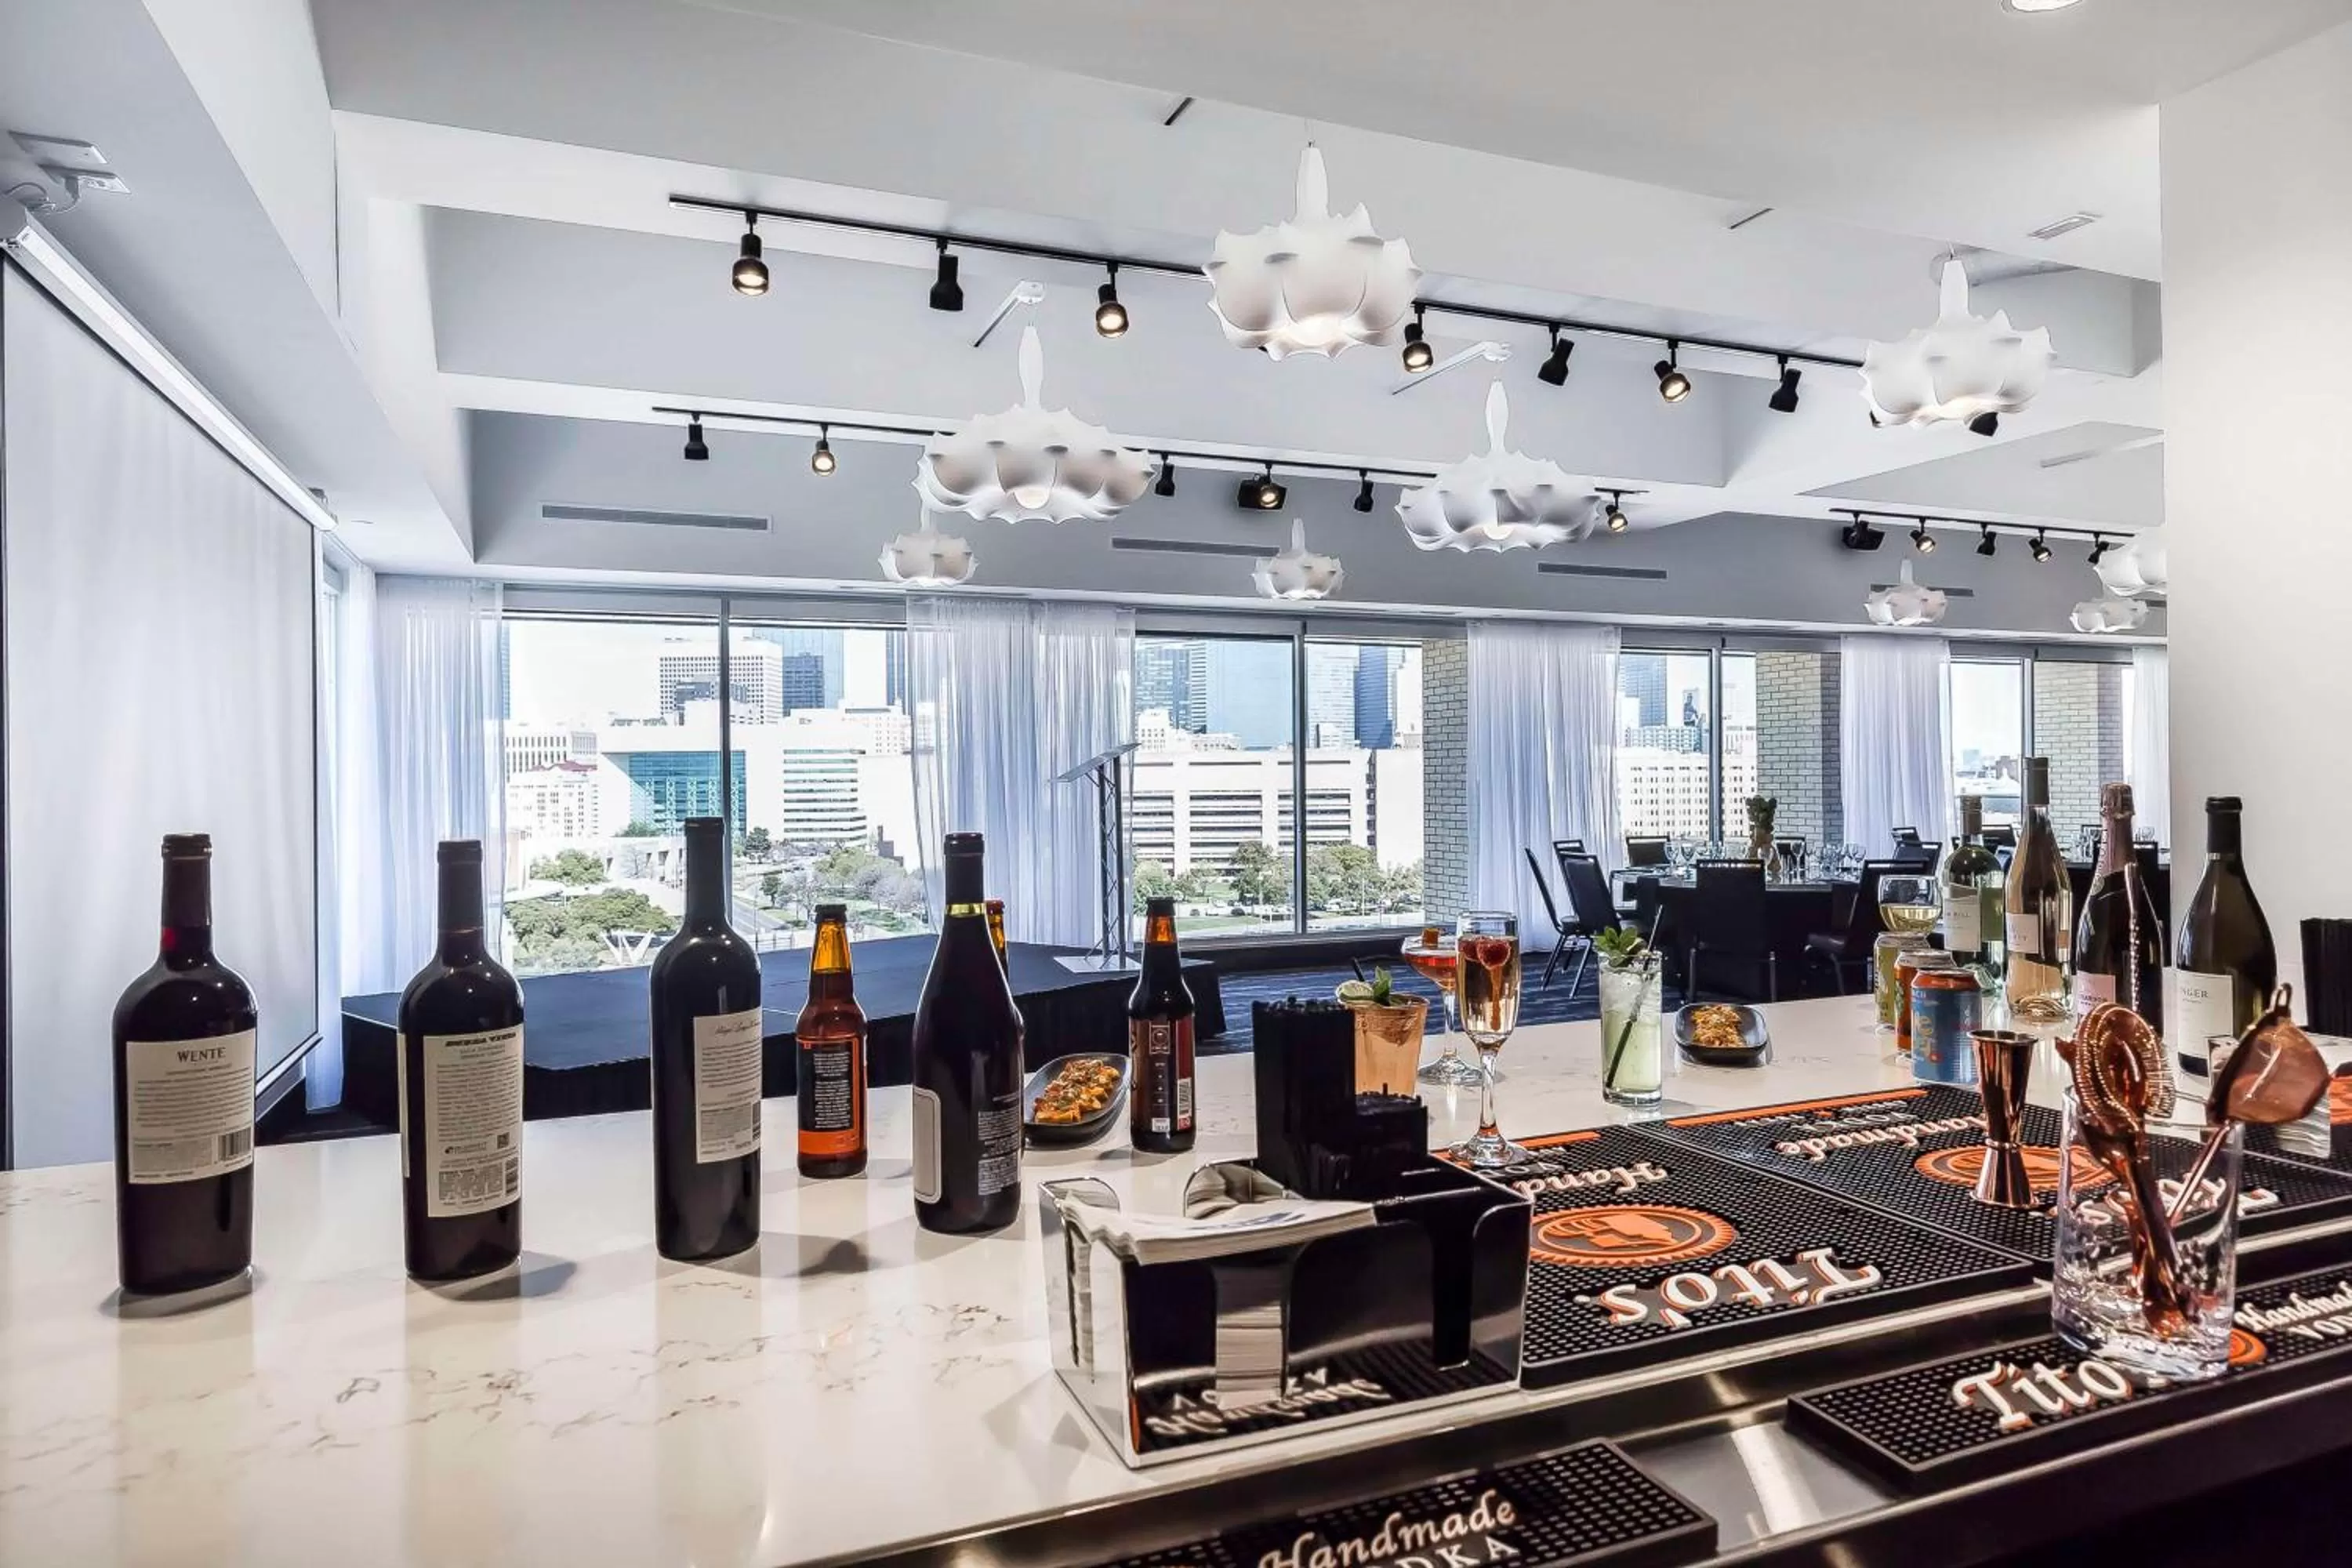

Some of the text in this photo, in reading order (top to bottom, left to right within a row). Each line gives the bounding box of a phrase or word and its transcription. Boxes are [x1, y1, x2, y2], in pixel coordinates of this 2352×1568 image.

[177, 1047, 226, 1062] WENTE
[1475, 1161, 1563, 1179] VOD
[1512, 1161, 1668, 1204] Hand
[1599, 1248, 1882, 1328] Tito's
[2234, 1280, 2352, 1332] Handma
[2287, 1314, 2352, 1340] VOD
[1952, 1360, 2170, 1433] Tito
[1257, 1488, 1516, 1568] Handmade
[1368, 1536, 1519, 1568] DKA
